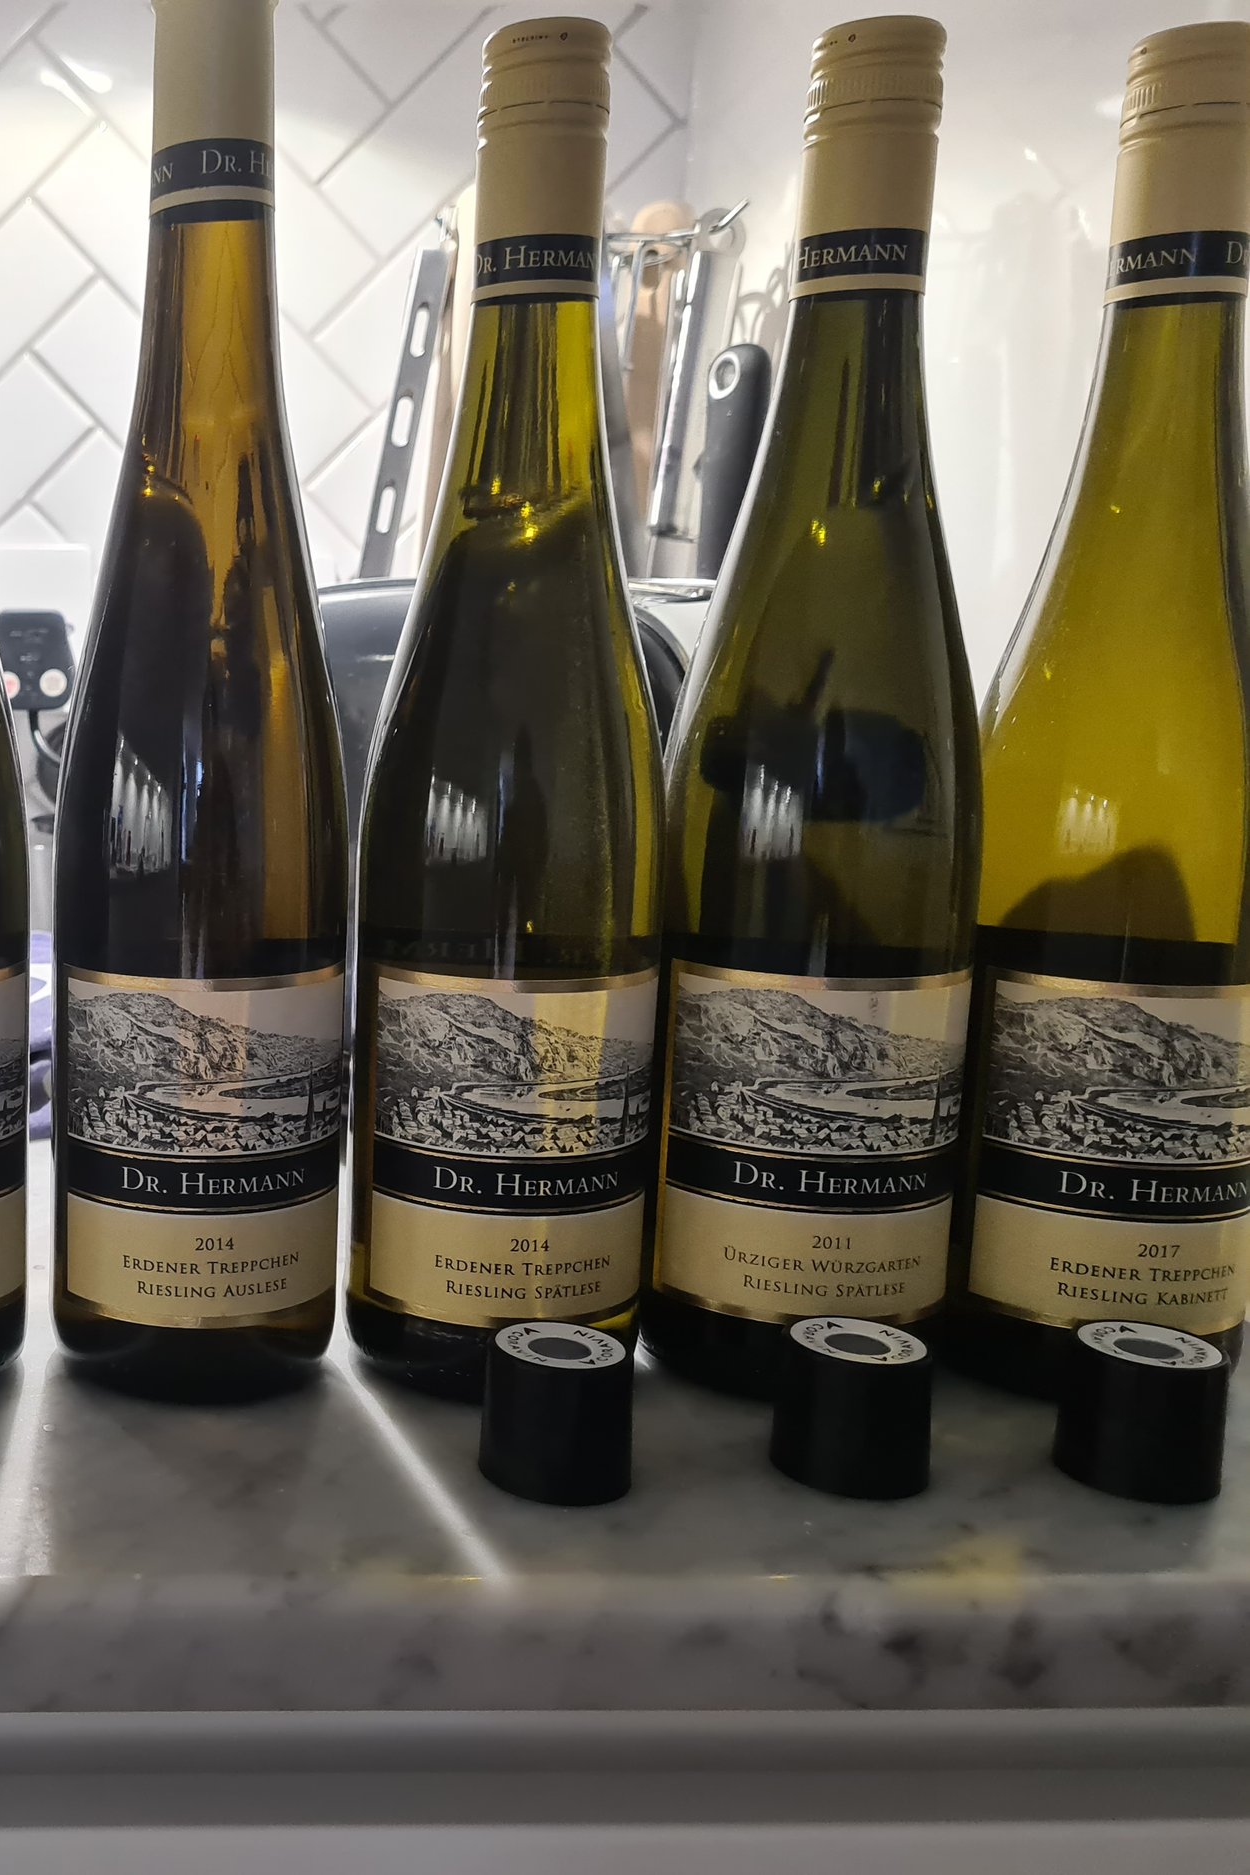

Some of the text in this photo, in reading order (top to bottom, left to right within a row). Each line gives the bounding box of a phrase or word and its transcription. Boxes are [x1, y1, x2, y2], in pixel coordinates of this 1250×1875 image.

[201, 149, 242, 174] DR.
[121, 1166, 305, 1196] DR. HERMANN
[432, 1166, 618, 1197] DR. HERMANN
[732, 1161, 926, 1195] DR. HERMANN
[1057, 1170, 1248, 1204] DR. HERMANN
[195, 1237, 234, 1252] 2014
[510, 1238, 550, 1253] 2014
[812, 1235, 852, 1250] 2011
[1137, 1243, 1180, 1258] 2017
[122, 1251, 300, 1274] ERDENER TREPPCHEN
[434, 1254, 611, 1276] ERDENER TREPPCHEN
[723, 1245, 921, 1274] ÜRZIGER WÜRZGARTEN
[1050, 1256, 1236, 1282] ERDENER TREPPCHEN
[137, 1277, 287, 1297] RIESLING AUSLESE
[445, 1279, 601, 1299] RIESLING SPÄTLESE
[743, 1273, 906, 1297] RIESLING SPÄTLESE
[1057, 1282, 1228, 1305] RIESLING KABINETT
